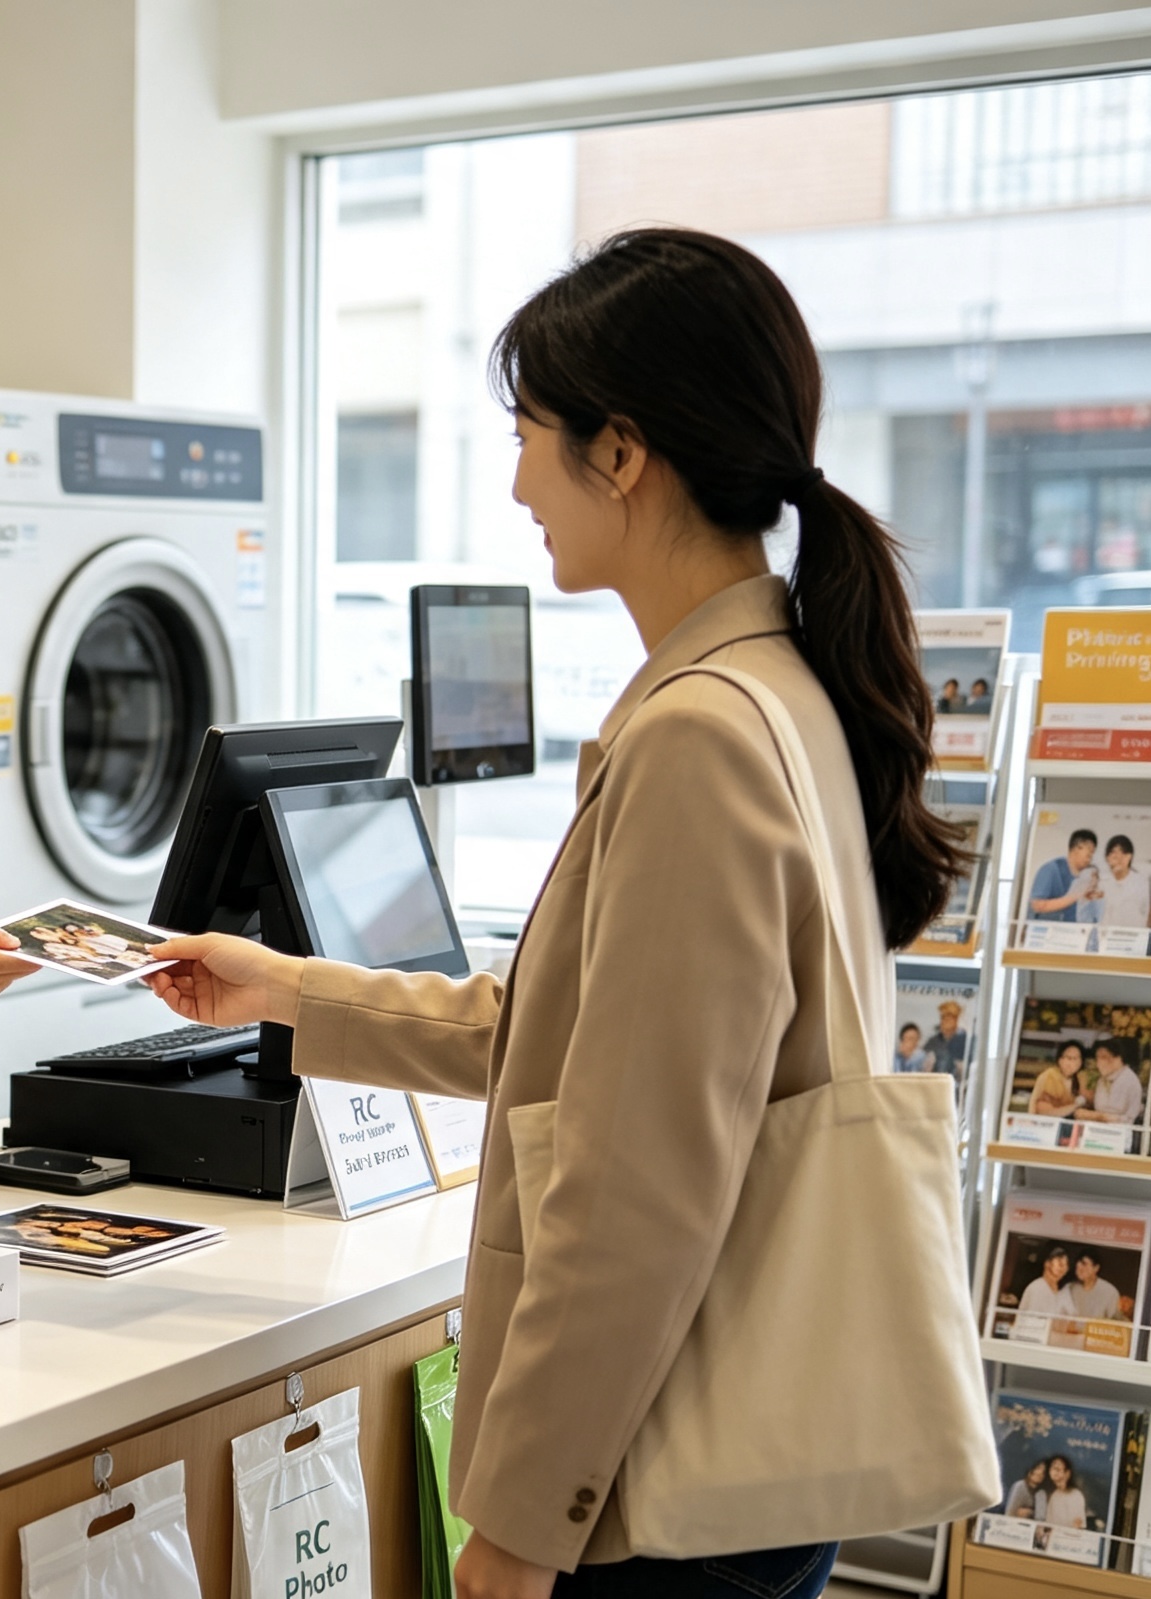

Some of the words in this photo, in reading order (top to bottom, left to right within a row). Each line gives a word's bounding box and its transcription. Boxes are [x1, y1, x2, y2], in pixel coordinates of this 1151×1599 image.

[349, 1093, 380, 1125] RC
[295, 1520, 331, 1564] RC
[285, 1561, 348, 1599] Photo
